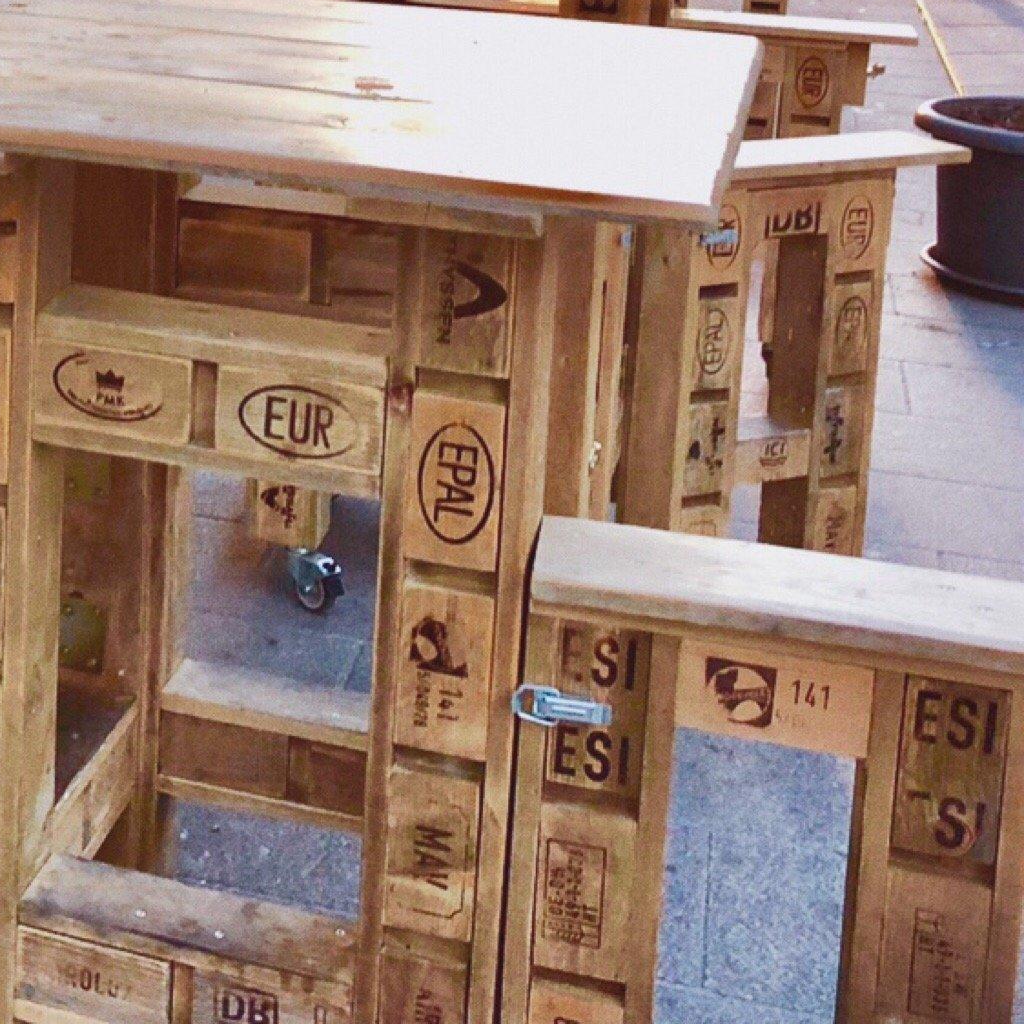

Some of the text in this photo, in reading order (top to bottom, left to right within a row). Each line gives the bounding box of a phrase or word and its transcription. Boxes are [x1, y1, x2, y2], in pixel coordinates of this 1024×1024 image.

[264, 394, 334, 450] EUR
[434, 440, 478, 524] EPAL
[791, 678, 831, 711] 141
[914, 689, 998, 755] ESI
[554, 722, 630, 785] ESI
